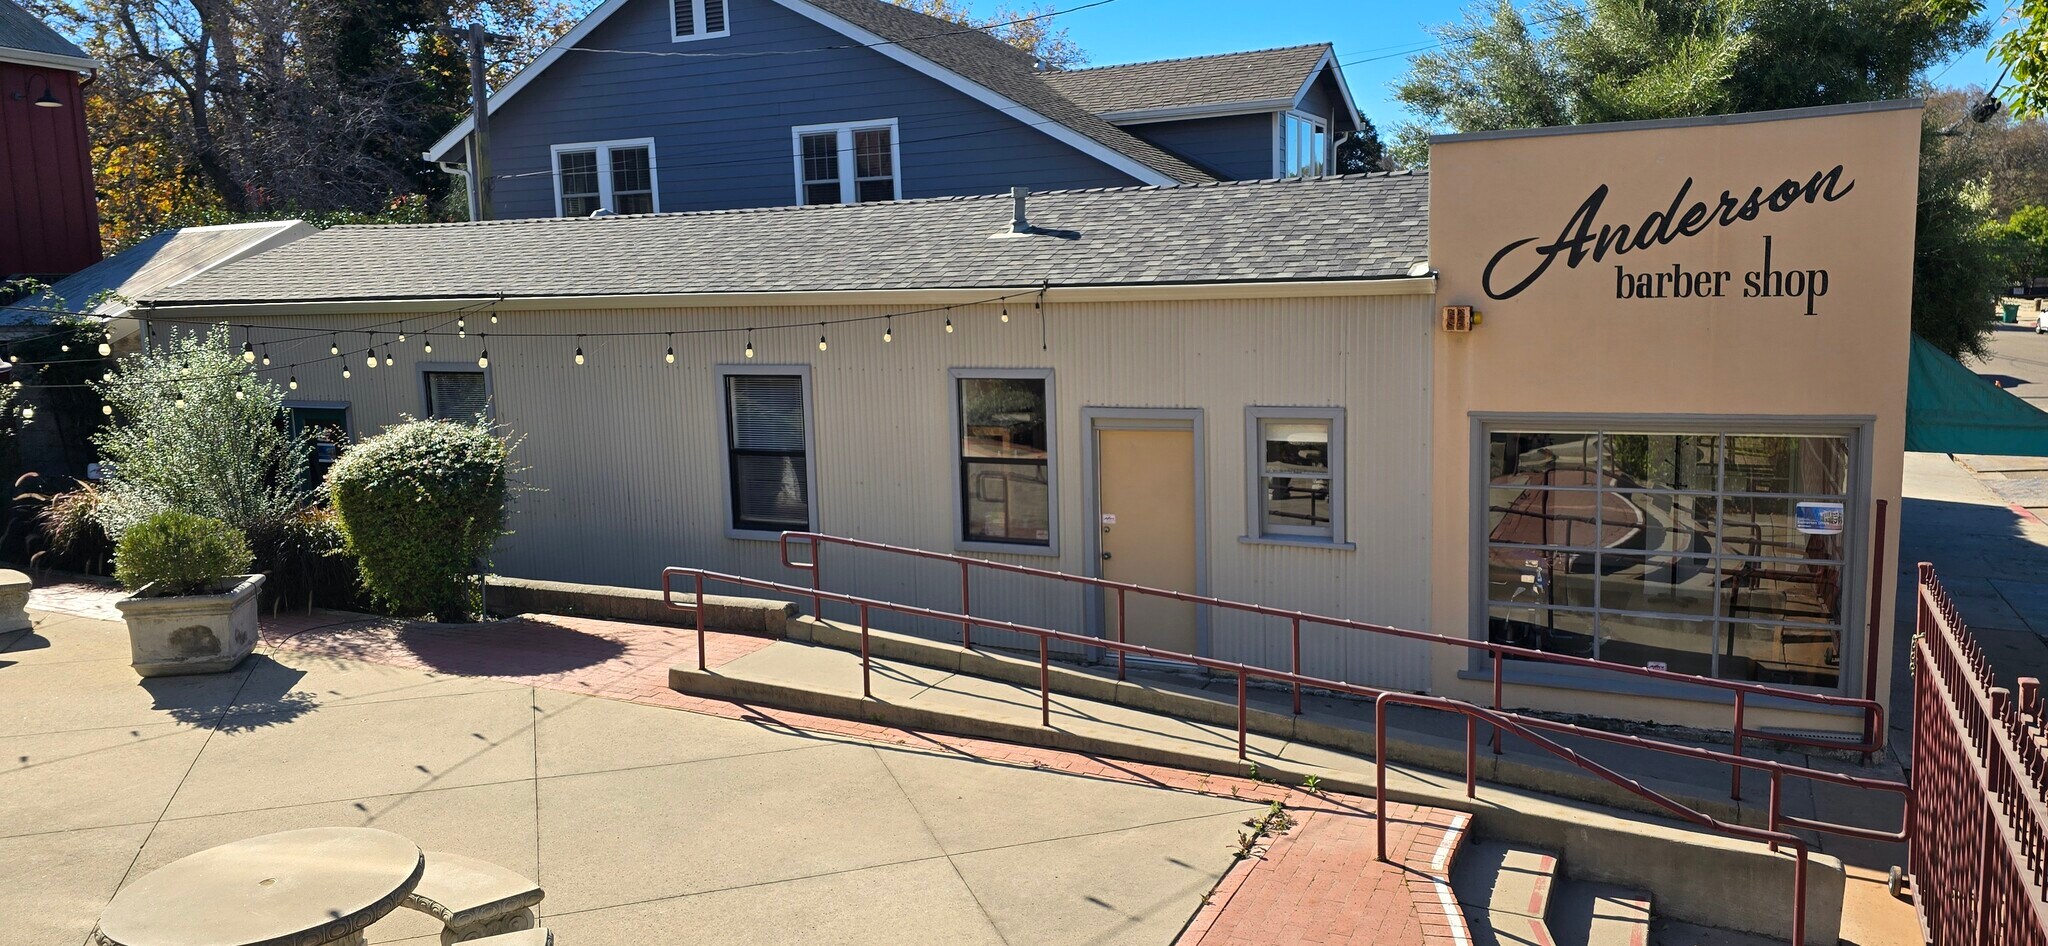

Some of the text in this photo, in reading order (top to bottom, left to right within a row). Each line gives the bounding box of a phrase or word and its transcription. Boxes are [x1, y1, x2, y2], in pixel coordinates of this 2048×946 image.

[1482, 164, 1855, 300] Anderson
[1615, 236, 1829, 316] barber shop
